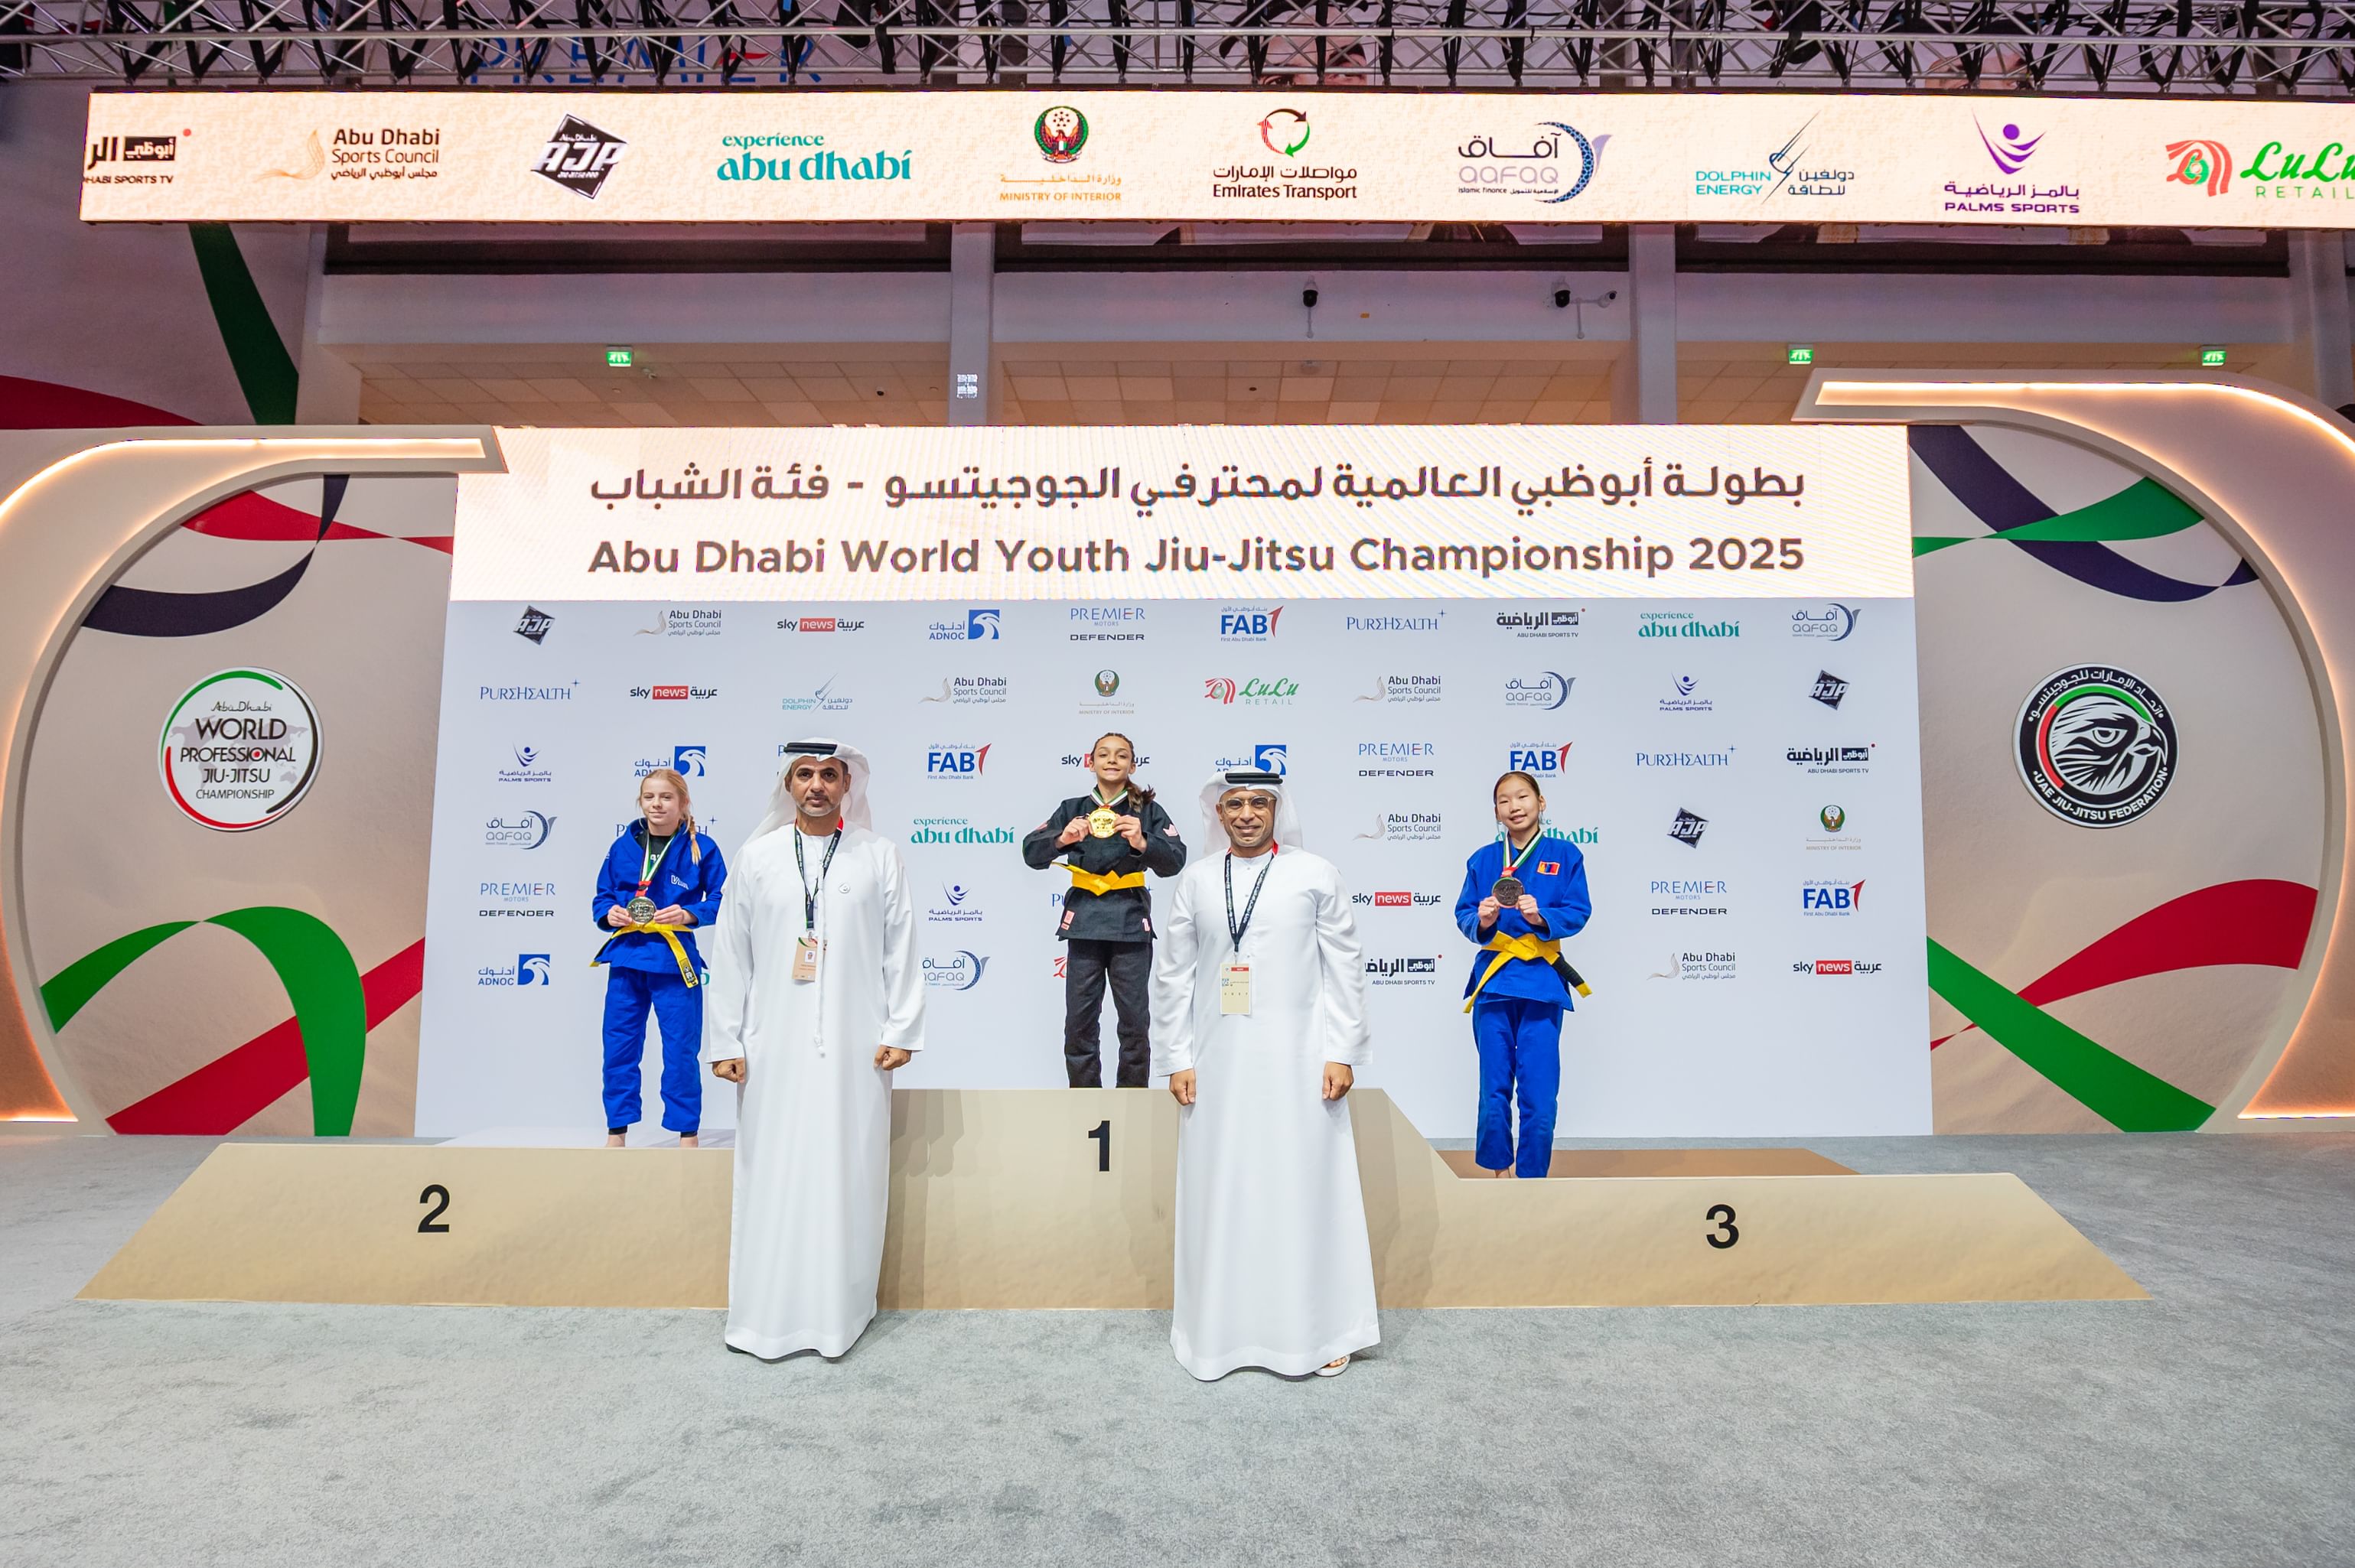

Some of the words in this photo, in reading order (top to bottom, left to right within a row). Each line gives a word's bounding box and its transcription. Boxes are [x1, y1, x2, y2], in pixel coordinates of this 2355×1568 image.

[334, 128, 373, 145] Abu
[381, 128, 439, 145] Dhabi
[125, 138, 174, 159] أبوظبي
[1458, 133, 1561, 158] آفاق
[332, 148, 380, 165] Sports
[386, 148, 438, 163] Council
[531, 142, 627, 171] AJP
[2240, 142, 2355, 182] LuLu
[717, 151, 790, 181] abu
[83, 175, 112, 184] HABI
[331, 168, 366, 181] الرياضي
[370, 166, 405, 181] أبوظبي
[408, 168, 437, 179] مجلس
[999, 173, 1093, 186] الداخلية
[1096, 173, 1122, 186] وزارة
[1213, 166, 1273, 181] الإمارات
[1281, 166, 1357, 183] مواصلات
[1695, 170, 1771, 184] DOLPHIN
[1800, 170, 1854, 182] دولفين
[1213, 184, 1279, 197] Emirates
[1283, 184, 1357, 200] Transport
[1695, 184, 1763, 198] ENERGY
[1788, 185, 1845, 195] للطاقة
[1944, 181, 2024, 198] الرياضية
[2031, 185, 2079, 199] بالمز
[2256, 186, 2354, 200] RETAIL
[999, 193, 1050, 201] MINISTRY
[1054, 193, 1067, 201] OF
[1071, 193, 1121, 201] INTERIOR
[1945, 202, 2004, 212] PALMS
[2011, 203, 2080, 213] SPORTS
[591, 462, 742, 510] الشباب
[751, 463, 829, 499] فئة
[884, 466, 1119, 509] الجوجيتسو
[1332, 464, 1501, 508] العالمية
[1511, 457, 1653, 516] أبوظبي
[1664, 463, 1804, 508] بطولة
[1131, 463, 1322, 516] لمحترفي
[588, 541, 679, 574] Abu
[695, 538, 825, 573] Dhabi
[841, 539, 979, 574] World
[995, 538, 1129, 574] Youth
[1145, 536, 1334, 573] Jiu-Jitsu
[1350, 535, 1673, 580] Championship
[1689, 536, 1803, 571] 2025
[669, 610, 689, 619] Abu
[693, 610, 721, 619] Dhabi
[1071, 608, 1145, 620] PREMIER
[1497, 612, 1549, 630] الرياضية
[1552, 613, 1578, 624] أبوظبي
[1791, 607, 1838, 621] آفاق
[669, 620, 692, 629] Sports
[777, 619, 798, 632] sky
[802, 620, 834, 629] news
[838, 619, 864, 631] عربية
[929, 620, 966, 633] أدنوك
[1220, 614, 1268, 635] FAB
[1638, 621, 1677, 637] abu
[929, 633, 965, 641] ADNOC
[954, 678, 973, 686] Abu
[978, 677, 1006, 686] Dhabi
[1505, 675, 1552, 690] آفاق
[2090, 669, 2136, 689] الإمارات
[630, 686, 650, 700] sky
[654, 688, 686, 698] news
[690, 687, 717, 699] عربية
[953, 688, 977, 697] Sports
[1239, 678, 1299, 698] LuLu
[2032, 669, 2089, 718] للجوجيتسو
[236, 701, 272, 711] Dhabi
[2134, 686, 2162, 715] اتحاد
[195, 718, 287, 740] WORLD
[181, 747, 295, 762] PROFESSIONAL
[1360, 743, 1434, 755] PREMIER
[1842, 748, 1868, 761] أبوظبي
[634, 757, 672, 768] أدنوك
[927, 752, 975, 773] FAB
[1060, 754, 1082, 768] sky
[1215, 756, 1252, 767] أدنوك
[1510, 750, 1557, 771] FAB
[1787, 748, 1839, 766] الرياضية
[203, 768, 270, 783] JIU-JITSU
[196, 789, 274, 799] CHAMPIONSHIP
[2034, 773, 2055, 798] UAE
[2052, 794, 2106, 821] JIU-JITSU
[2109, 771, 2168, 820] FEDERATION
[486, 815, 533, 829] آفاق
[911, 828, 949, 844] abu
[480, 883, 555, 895] PREMIER
[1652, 881, 1726, 893] PREMIER
[1351, 893, 1373, 906] sky
[1377, 895, 1409, 904] news
[1414, 893, 1441, 906] عربية
[1803, 888, 1851, 909] FAB
[477, 965, 516, 978] أدنوك
[1409, 959, 1434, 971] أبوظبي
[1793, 961, 1814, 974] sky
[1818, 964, 1850, 973] news
[1855, 961, 1881, 974] عربية
[477, 978, 515, 986] ADNOC
[1089, 1121, 1110, 1172] 1
[418, 1184, 450, 1233] 2
[1706, 1204, 1739, 1249] 3
